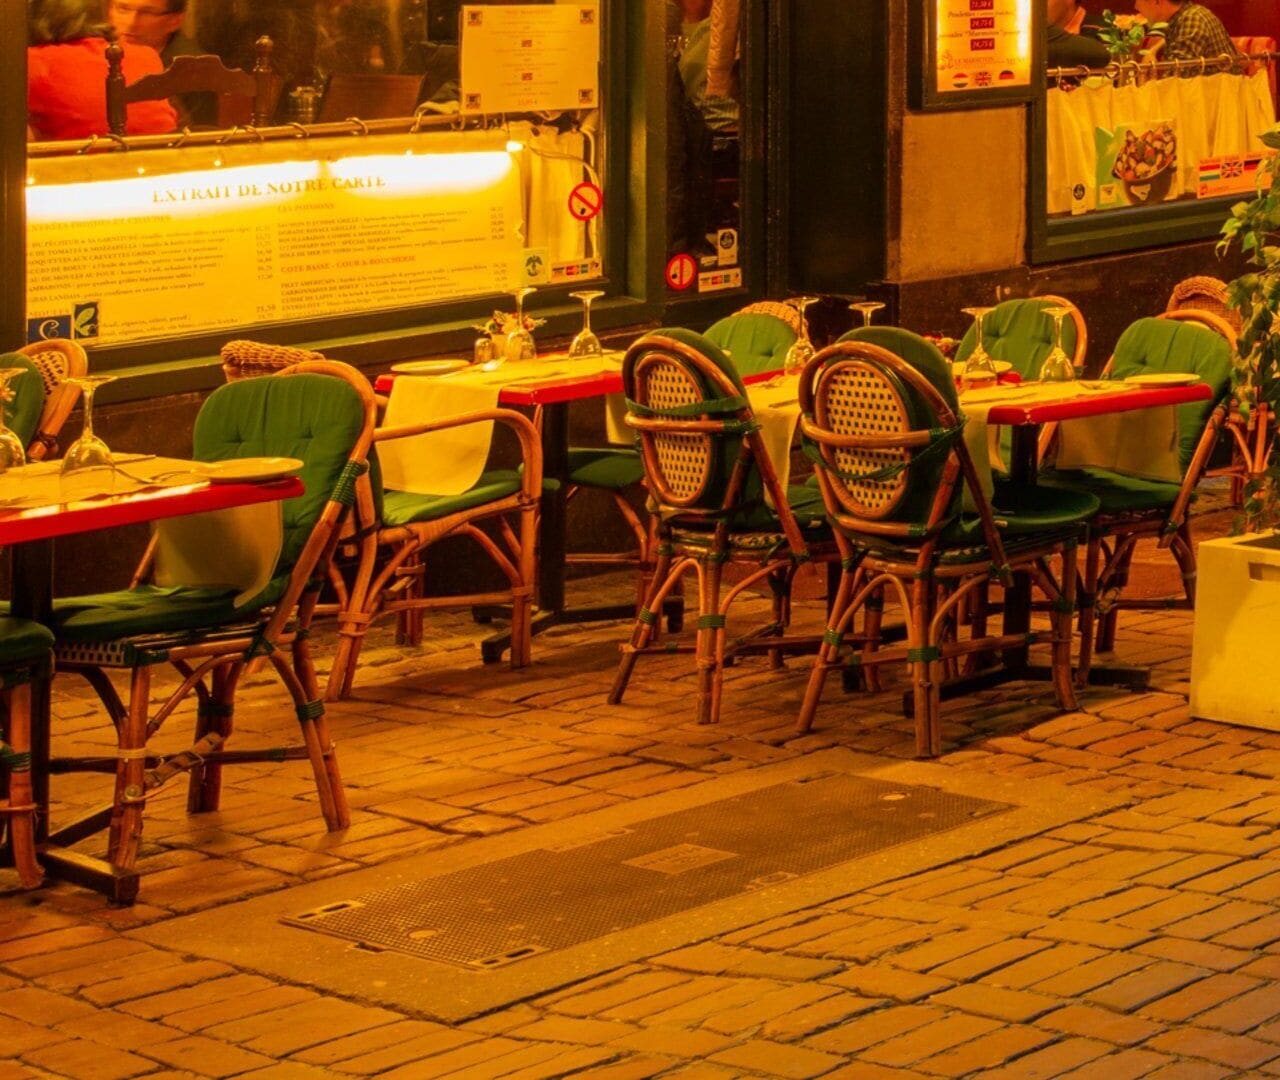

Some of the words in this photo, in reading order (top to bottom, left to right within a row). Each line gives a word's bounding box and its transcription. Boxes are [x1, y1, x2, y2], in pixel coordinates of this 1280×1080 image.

[152, 184, 232, 203] EXTRAIT
[238, 182, 262, 197] DE
[267, 177, 329, 195] NOTRE
[332, 176, 386, 190] CARTE
